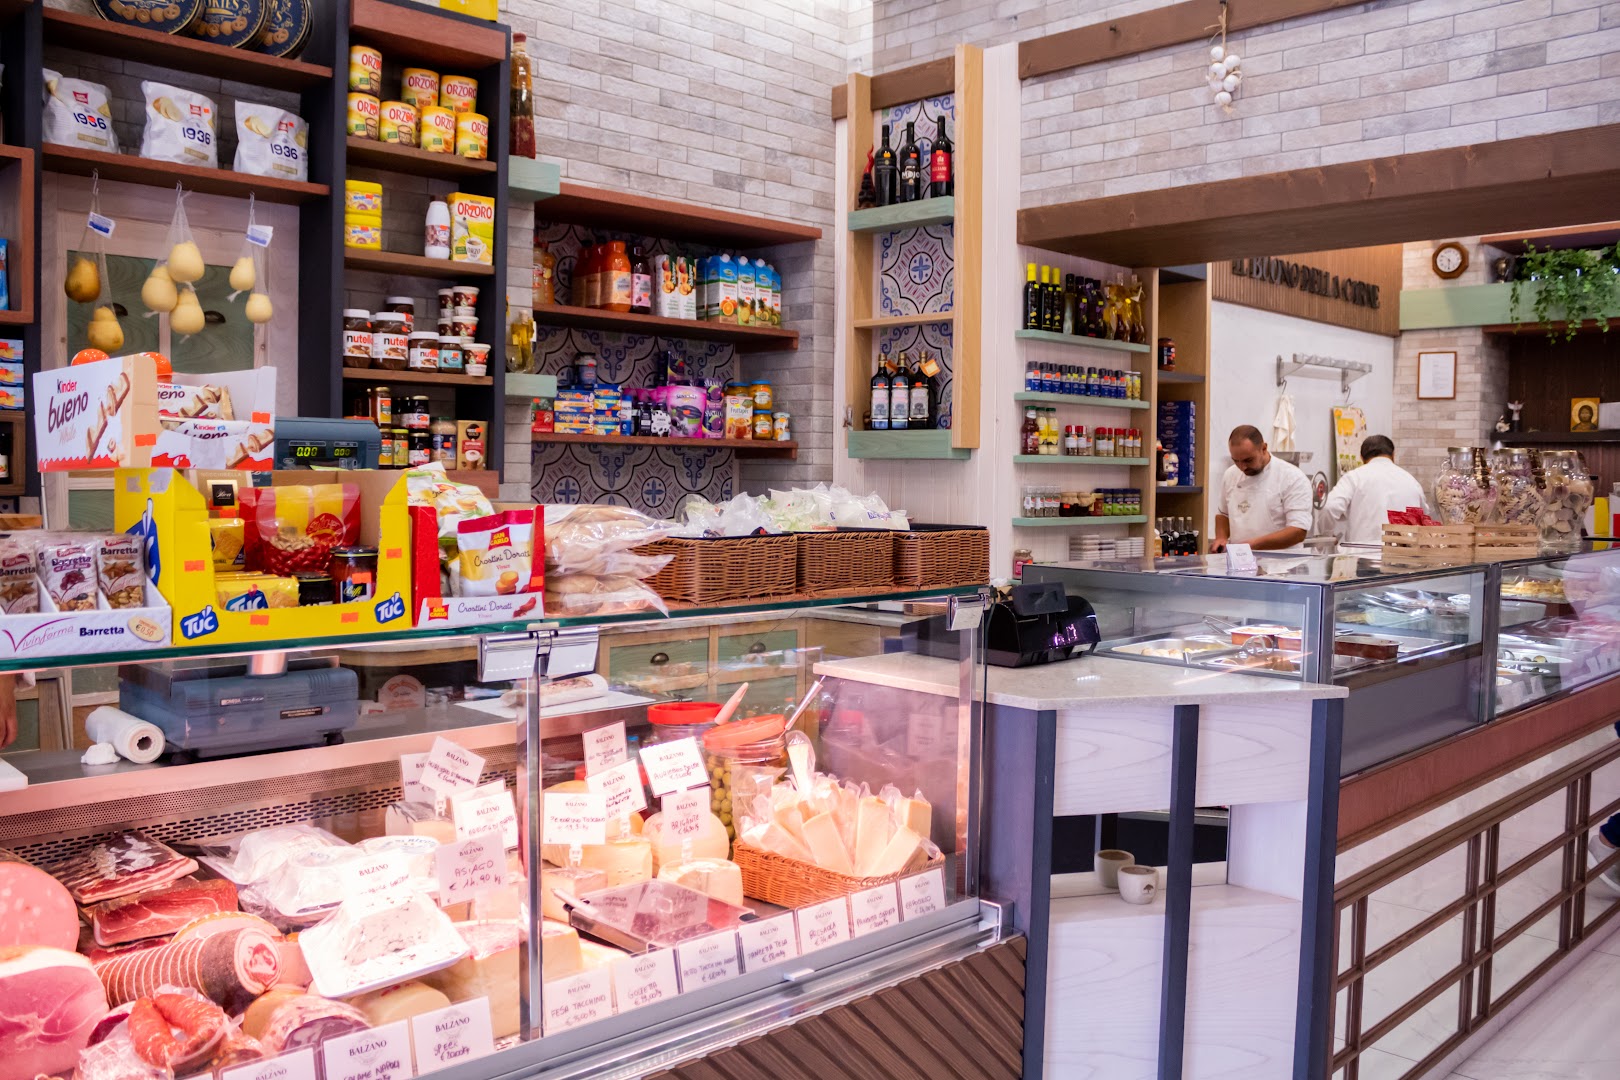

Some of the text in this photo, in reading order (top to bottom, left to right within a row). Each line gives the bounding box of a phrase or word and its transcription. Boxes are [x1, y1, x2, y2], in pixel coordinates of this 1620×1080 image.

[182, 126, 210, 146] 1936
[270, 143, 298, 160] 1936
[458, 202, 492, 219] ORZORO
[384, 338, 408, 347] nutell
[158, 390, 185, 400] eno
[48, 392, 88, 433] bueno
[490, 538, 509, 546] CARLO
[101, 547, 138, 555] Barretta
[52, 556, 91, 566] Barretta
[474, 549, 532, 567] Crostini Dorati
[0, 567, 36, 577] Barretta
[377, 603, 403, 622] TUC
[458, 600, 512, 613] Crostini Dorati
[80, 626, 124, 637] Barretta
[184, 616, 215, 637] TUC
[446, 751, 469, 766] BALZANO
[602, 775, 625, 787] BALZANO
[476, 806, 500, 816] BALZANO
[676, 802, 697, 810] BALZANO
[460, 846, 484, 856] BALZANO
[359, 864, 389, 876] BALZANO
[455, 860, 494, 877] ASIAGO
[635, 962, 656, 973] BALZANO
[568, 984, 591, 994] BALZANO
[551, 994, 606, 1017] FESA TACCHINO
[435, 1017, 470, 1033] BALZANO
[349, 1040, 387, 1056] BALZANO
